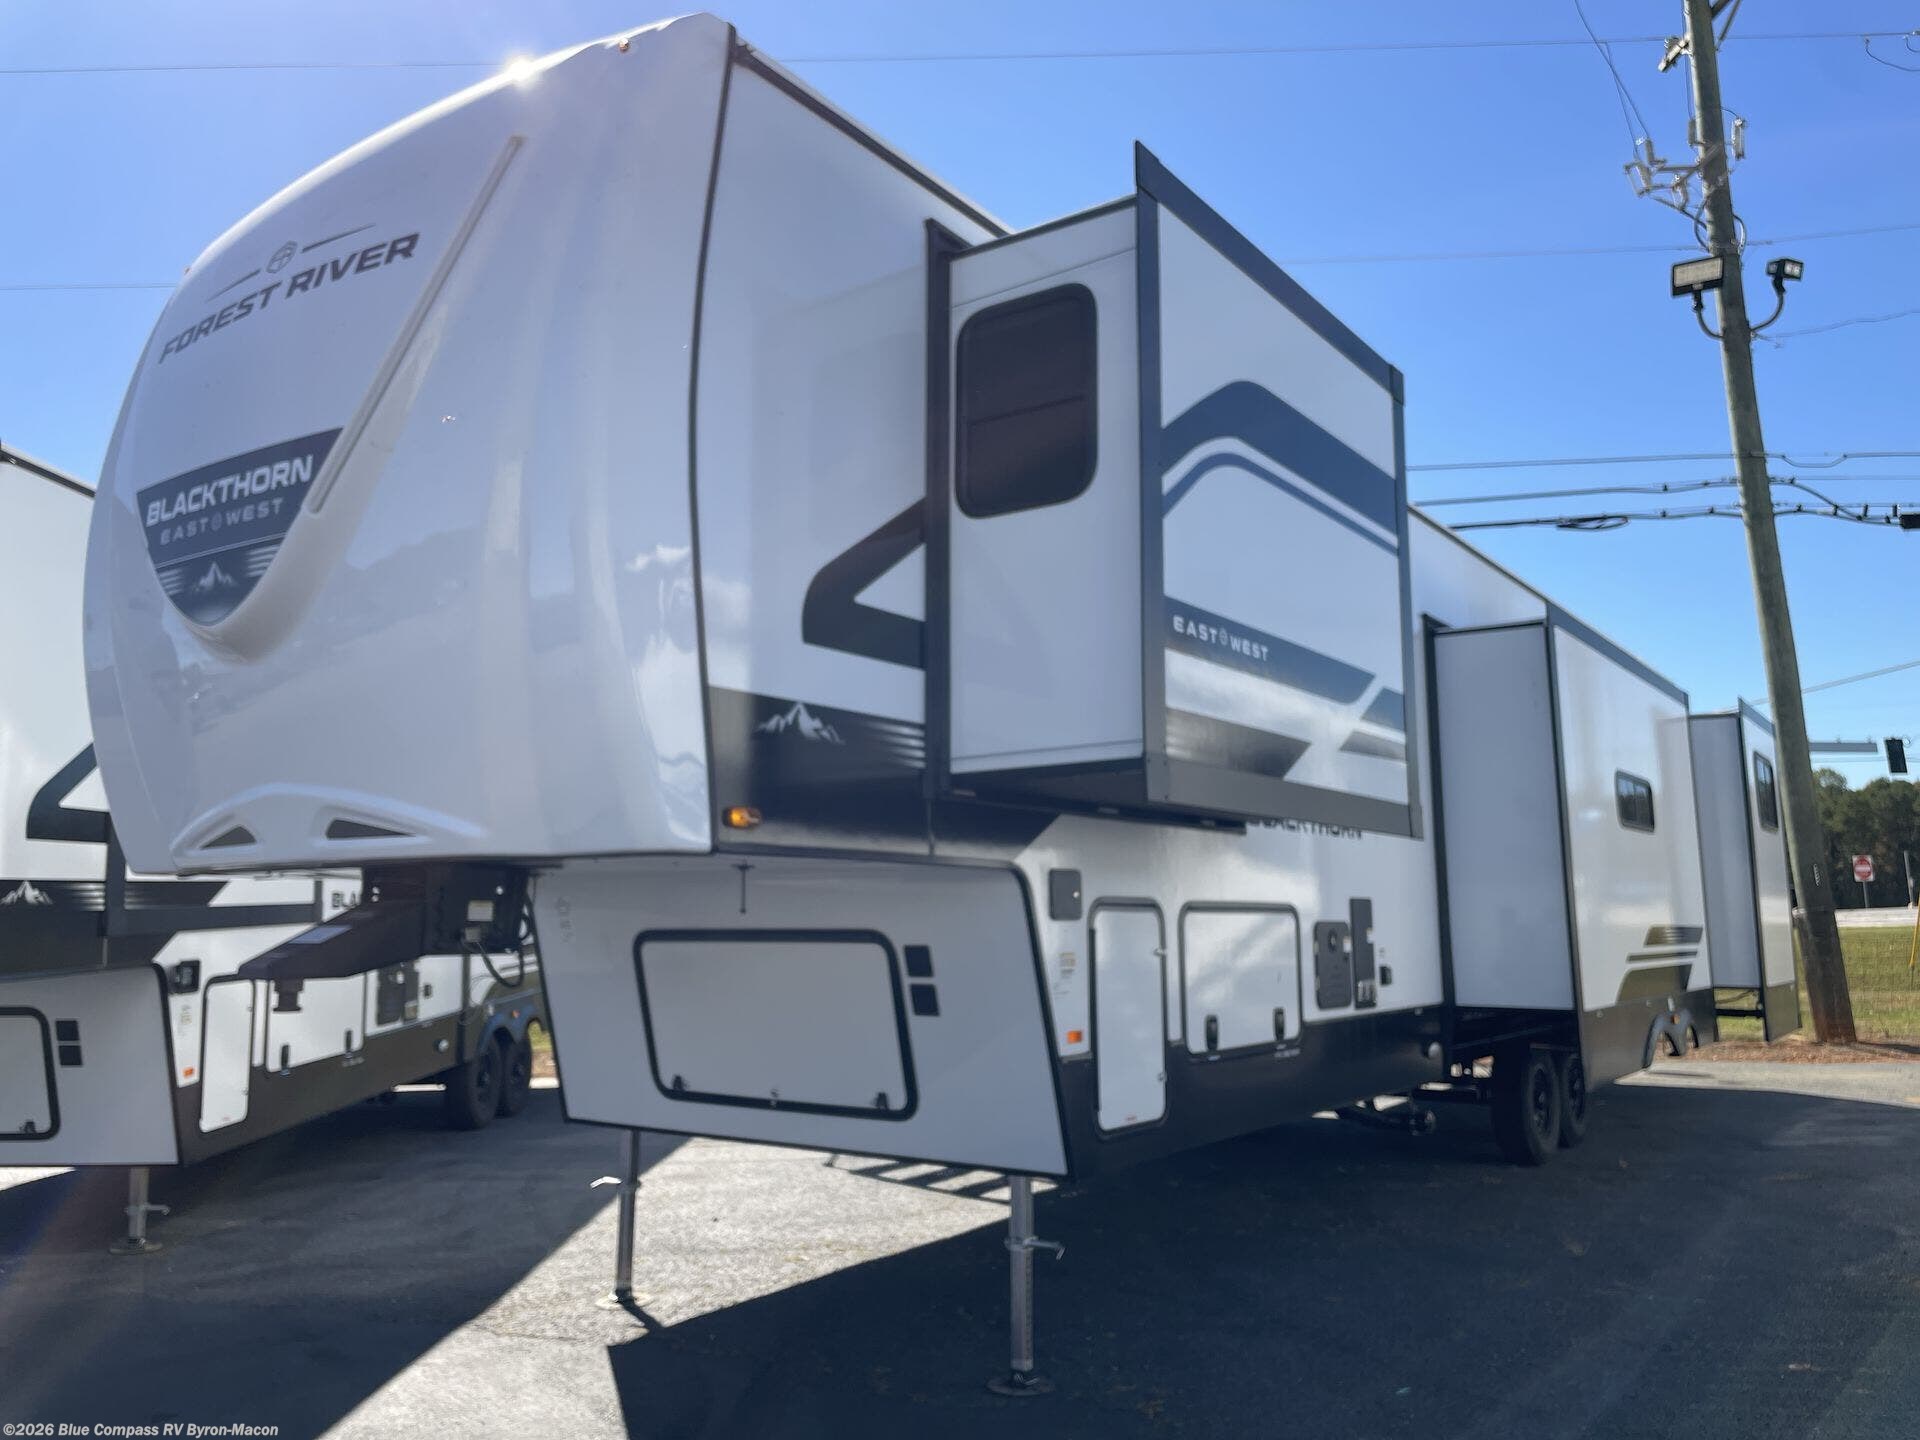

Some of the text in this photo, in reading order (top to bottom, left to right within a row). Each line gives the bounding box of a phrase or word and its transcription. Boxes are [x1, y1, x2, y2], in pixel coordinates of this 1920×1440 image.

[157, 232, 420, 365] FOREST RIVER
[145, 454, 314, 528] BLACKTHORN
[160, 497, 284, 546] EAST WEST
[1173, 614, 1269, 662] EAST WEST
